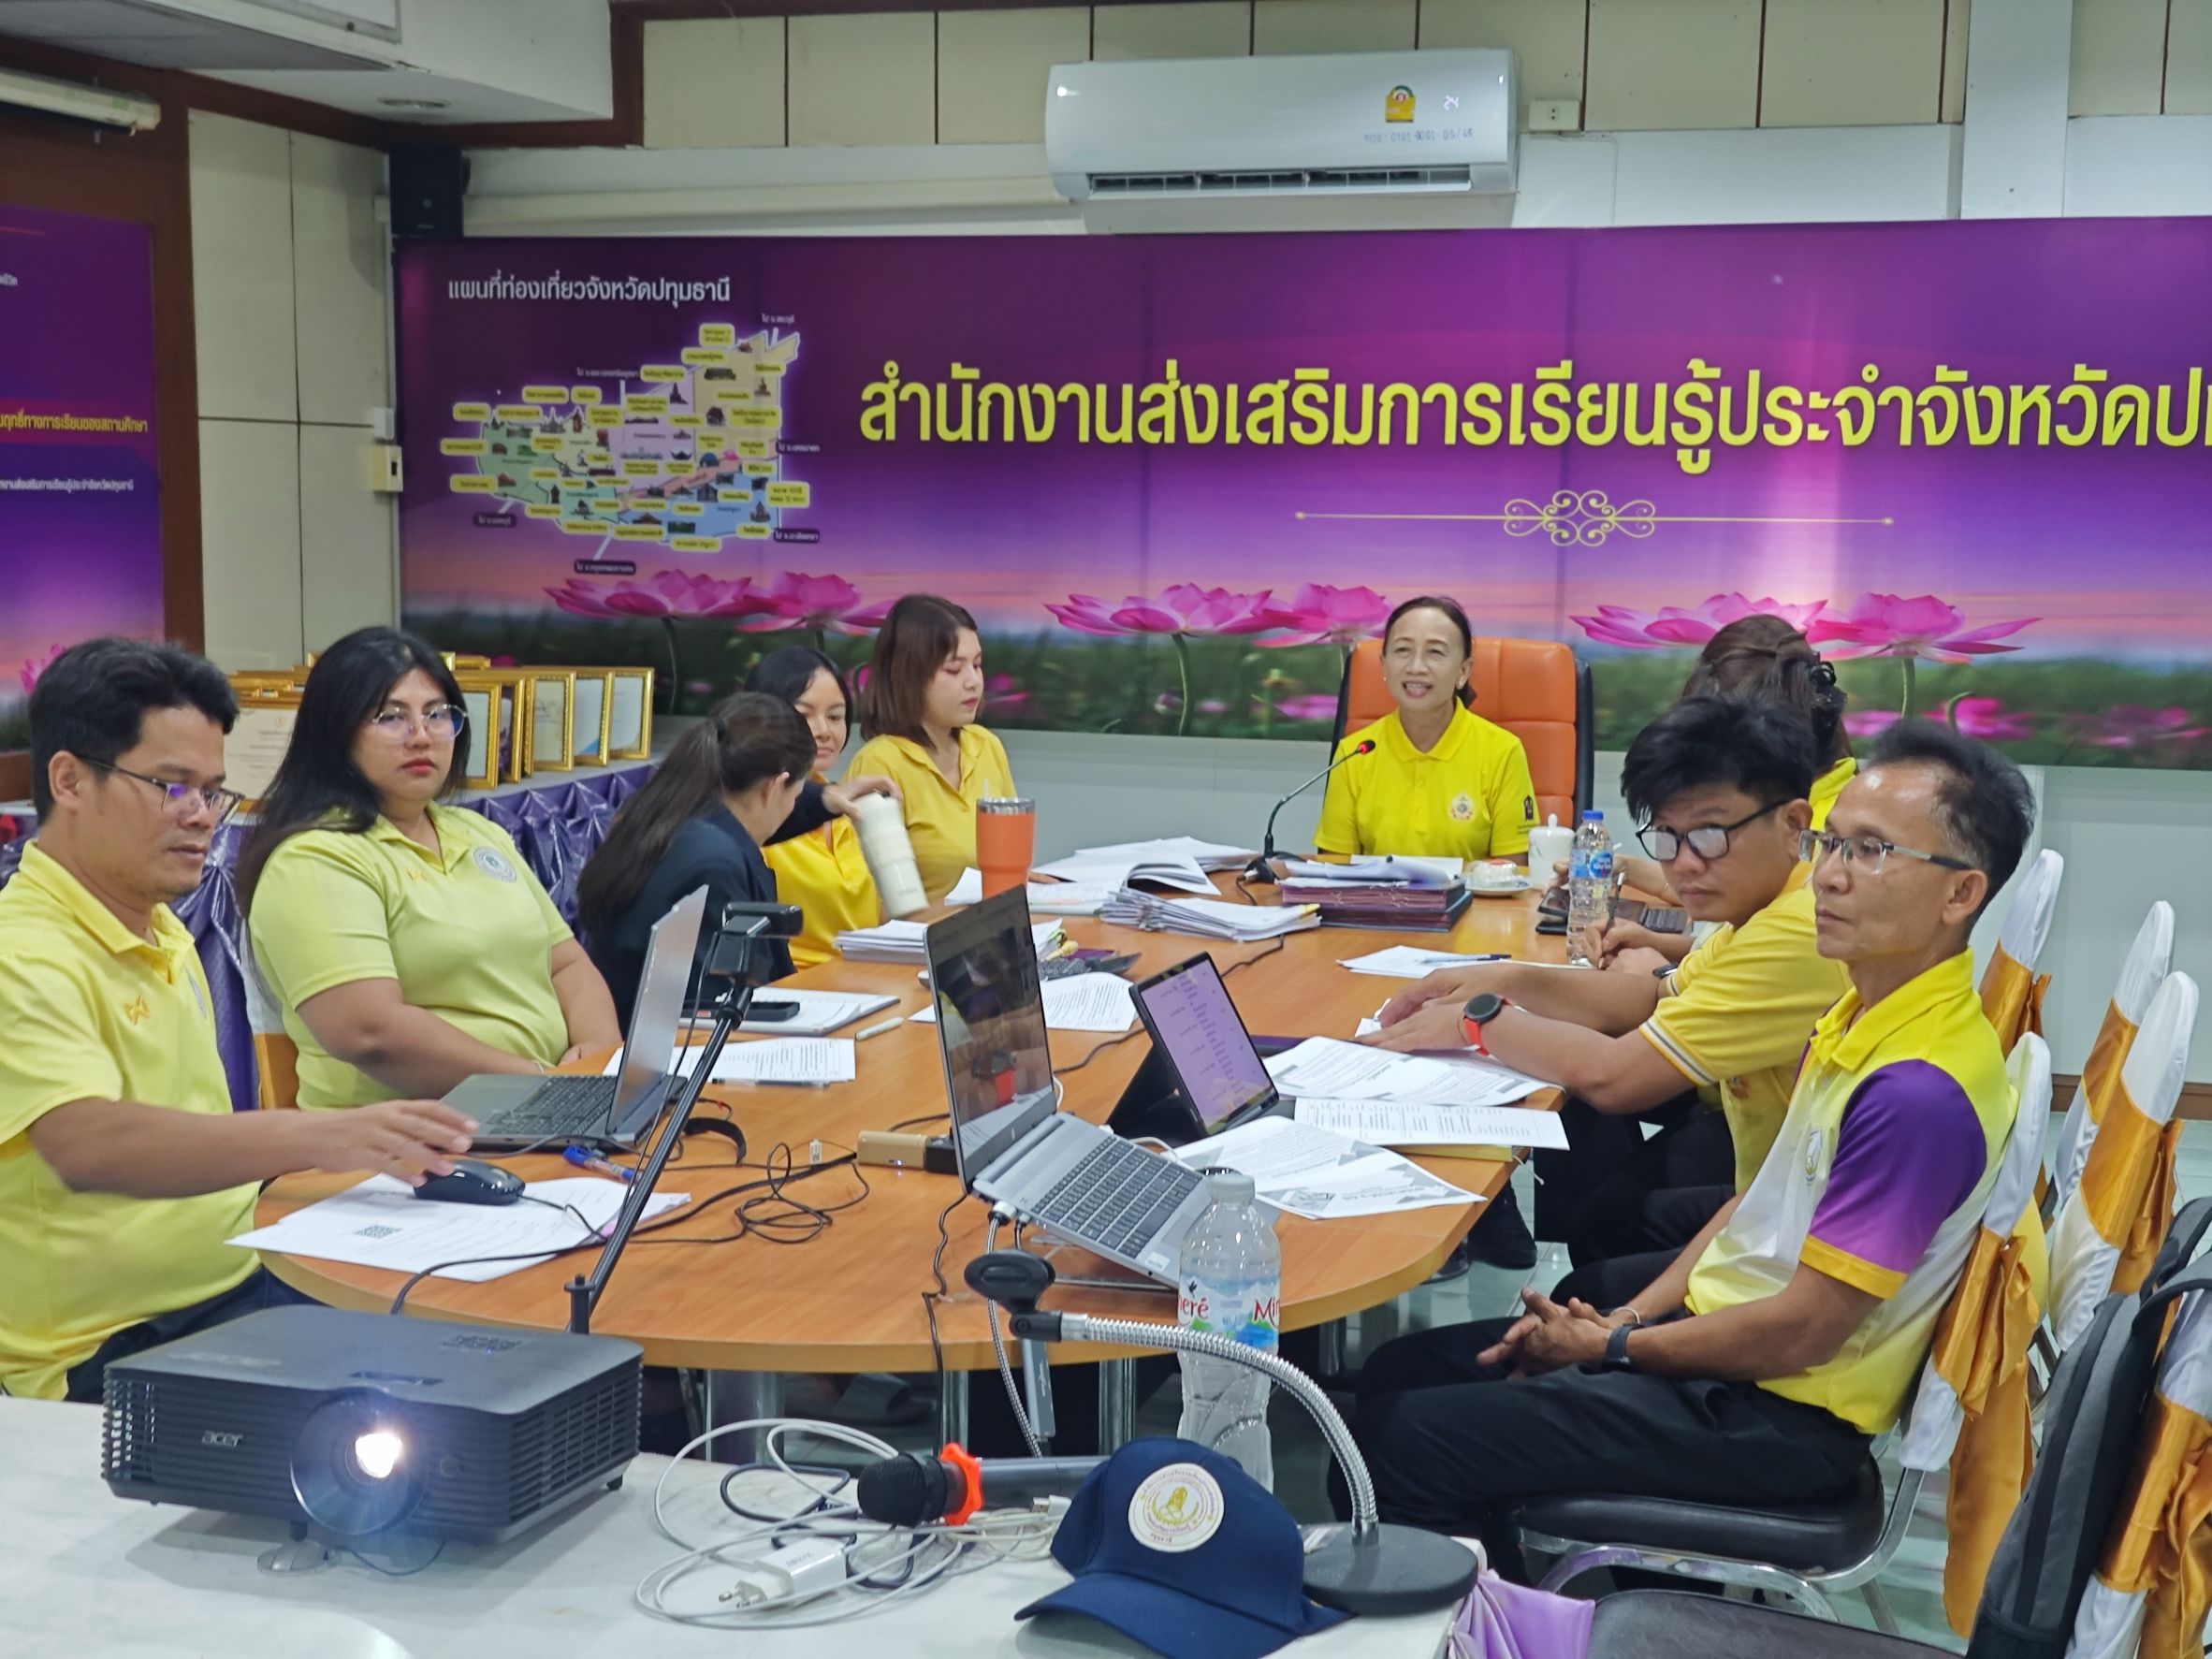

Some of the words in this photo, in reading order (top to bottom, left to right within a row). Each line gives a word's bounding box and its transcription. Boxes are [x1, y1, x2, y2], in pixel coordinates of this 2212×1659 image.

[1443, 95, 1460, 110] 24
[448, 269, 731, 309] แผนที่ท่องเที่ยวจังหวัดปทุมธานี
[860, 358, 2212, 474] สำนักงานส่งเสริมการเรียนรู้ประจำจังหวัดป
[201, 1430, 243, 1448] acer
